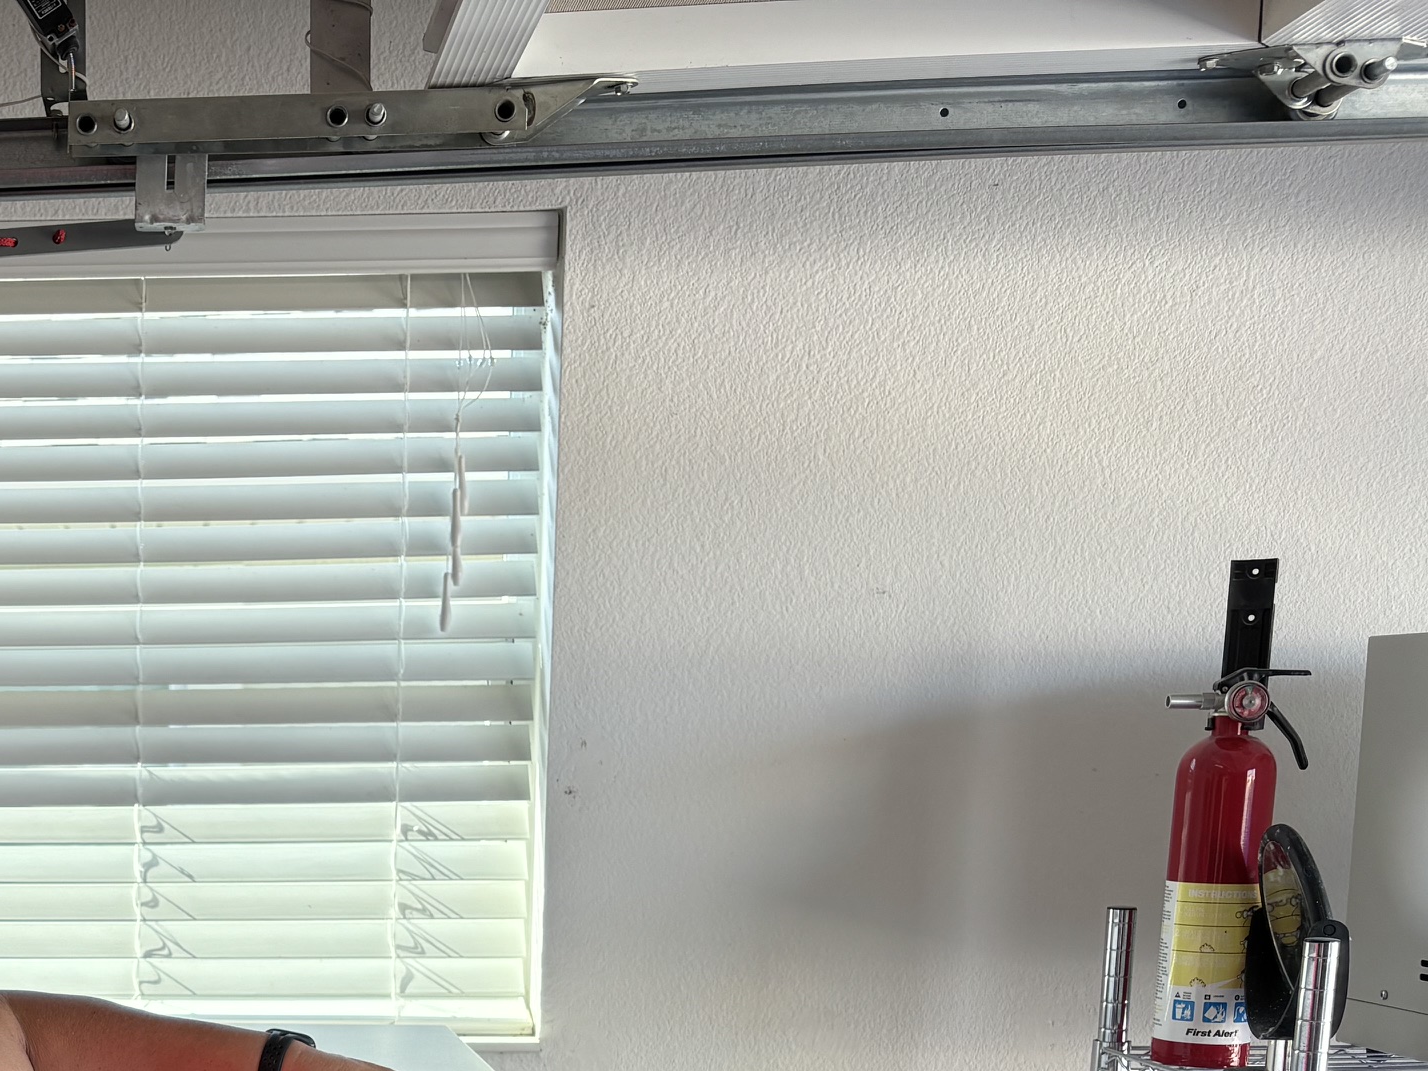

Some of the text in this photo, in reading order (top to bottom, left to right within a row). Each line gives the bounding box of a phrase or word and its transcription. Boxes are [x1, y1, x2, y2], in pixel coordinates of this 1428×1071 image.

[1188, 889, 1258, 899] INSTRUCTIONS
[1185, 1028, 1239, 1038] First Alert
